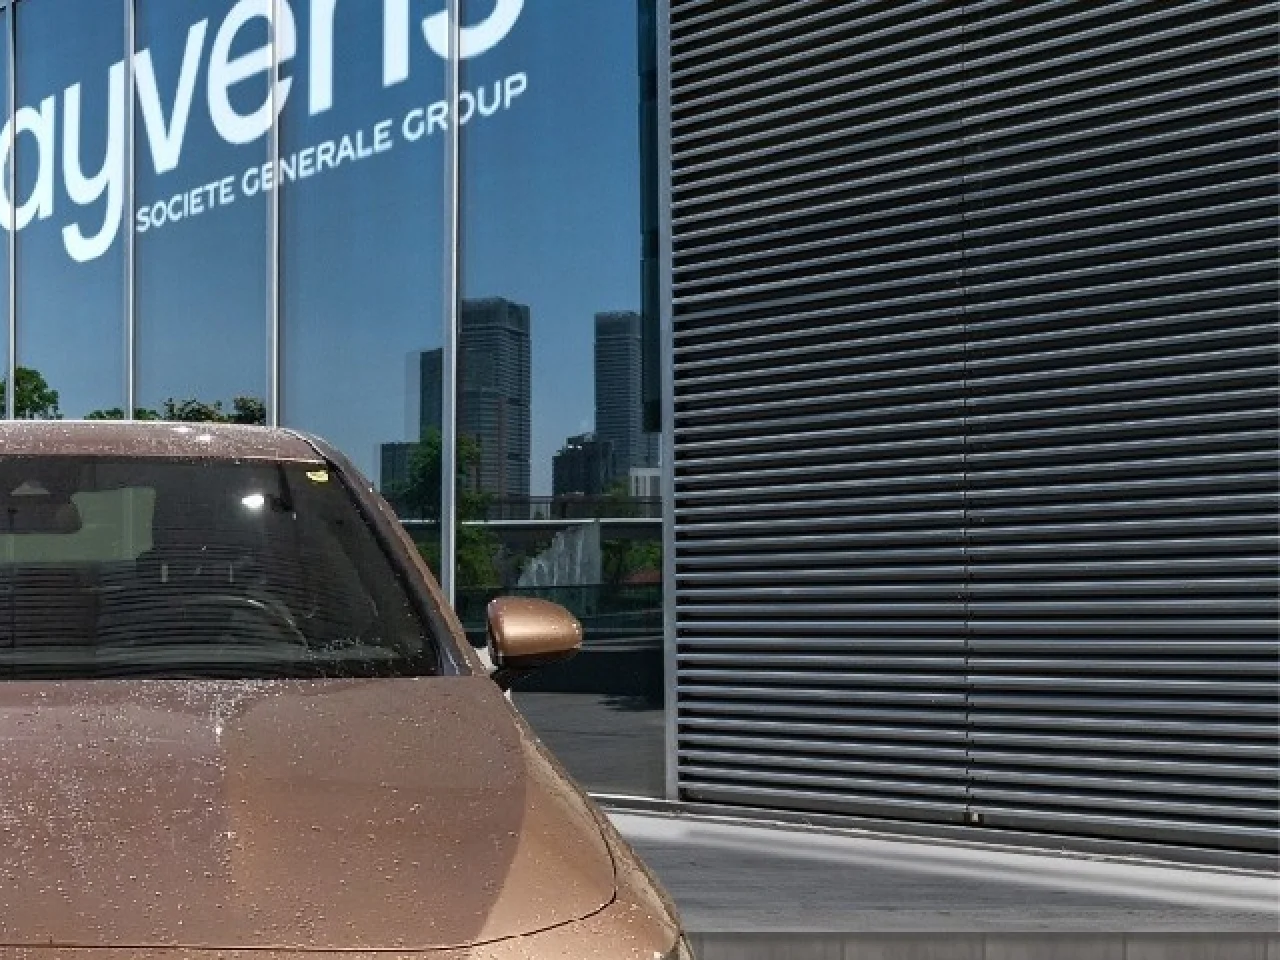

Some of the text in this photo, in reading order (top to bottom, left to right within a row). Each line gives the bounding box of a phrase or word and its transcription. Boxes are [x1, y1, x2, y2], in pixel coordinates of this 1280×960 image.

[135, 71, 528, 232] SOCIETE GENERALE GROUP
